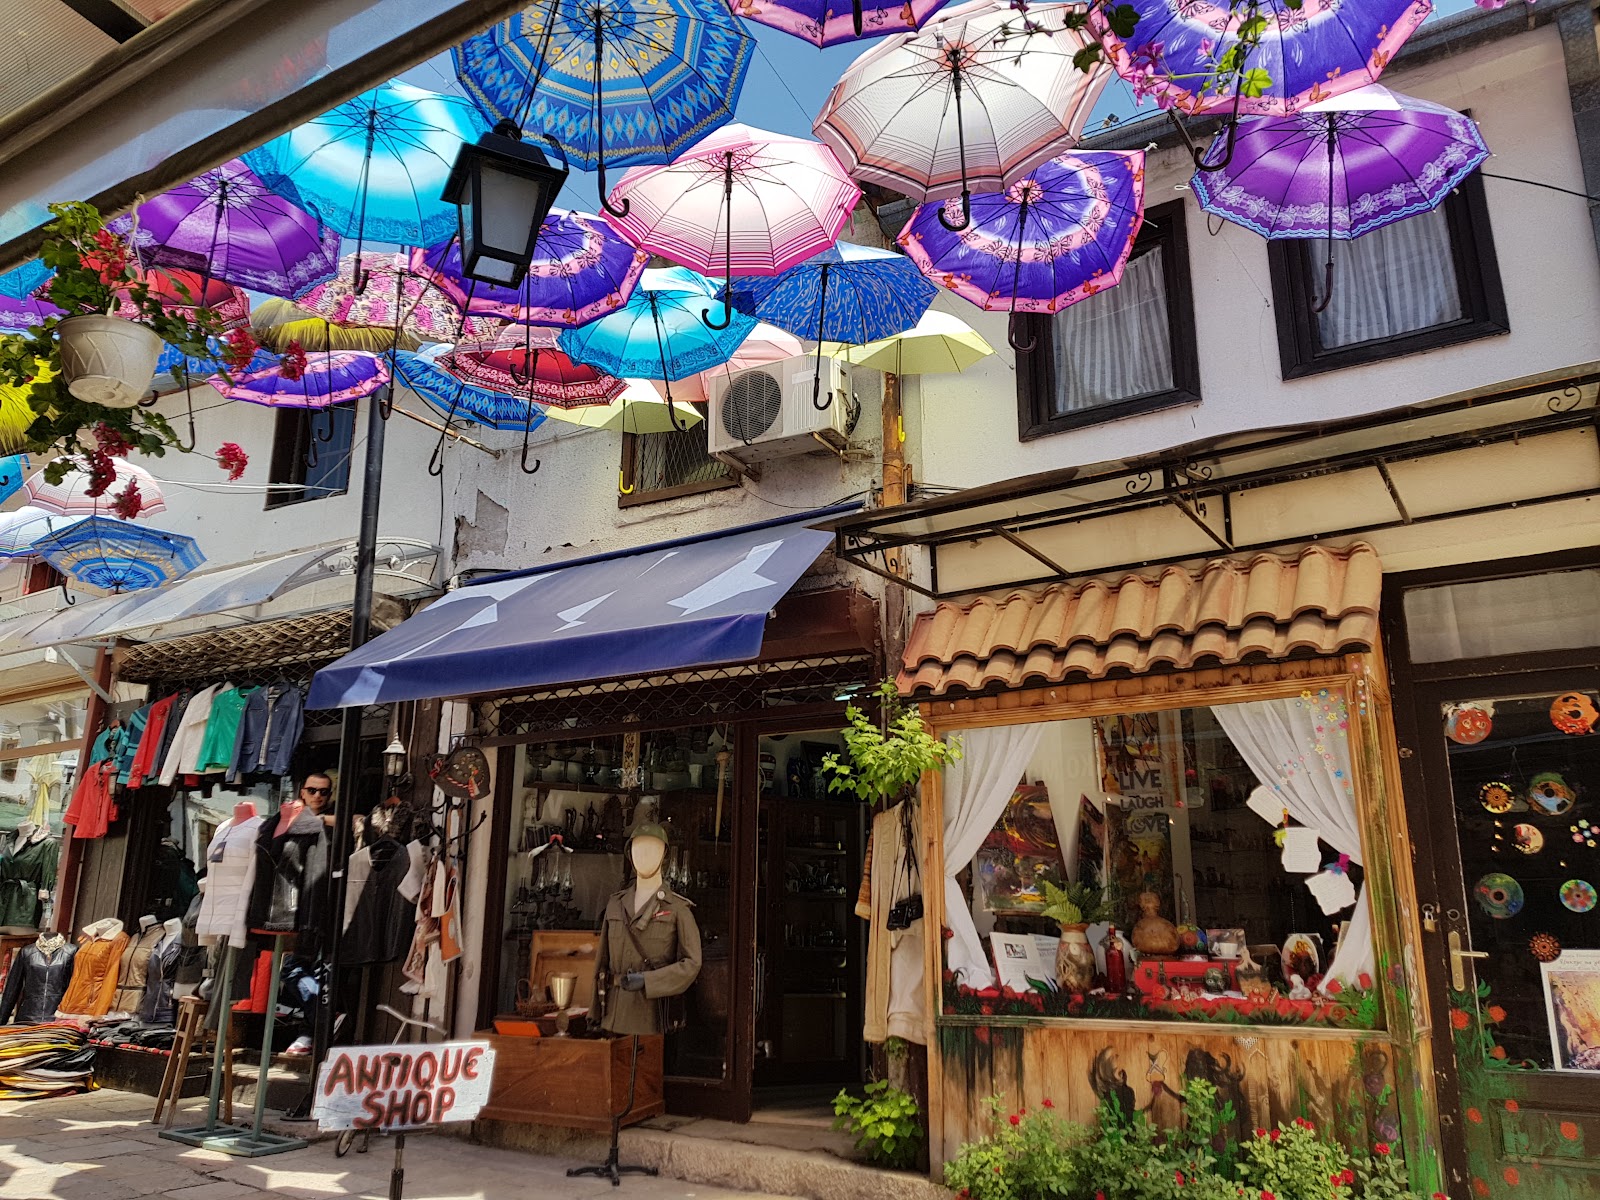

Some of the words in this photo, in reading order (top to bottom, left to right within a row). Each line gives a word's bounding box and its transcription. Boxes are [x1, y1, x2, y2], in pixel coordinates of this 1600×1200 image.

[1118, 769, 1162, 791] LIVE
[1120, 795, 1164, 812] LAUGH
[324, 1046, 484, 1097] ANTIQUE
[352, 1086, 456, 1129] SHOP
